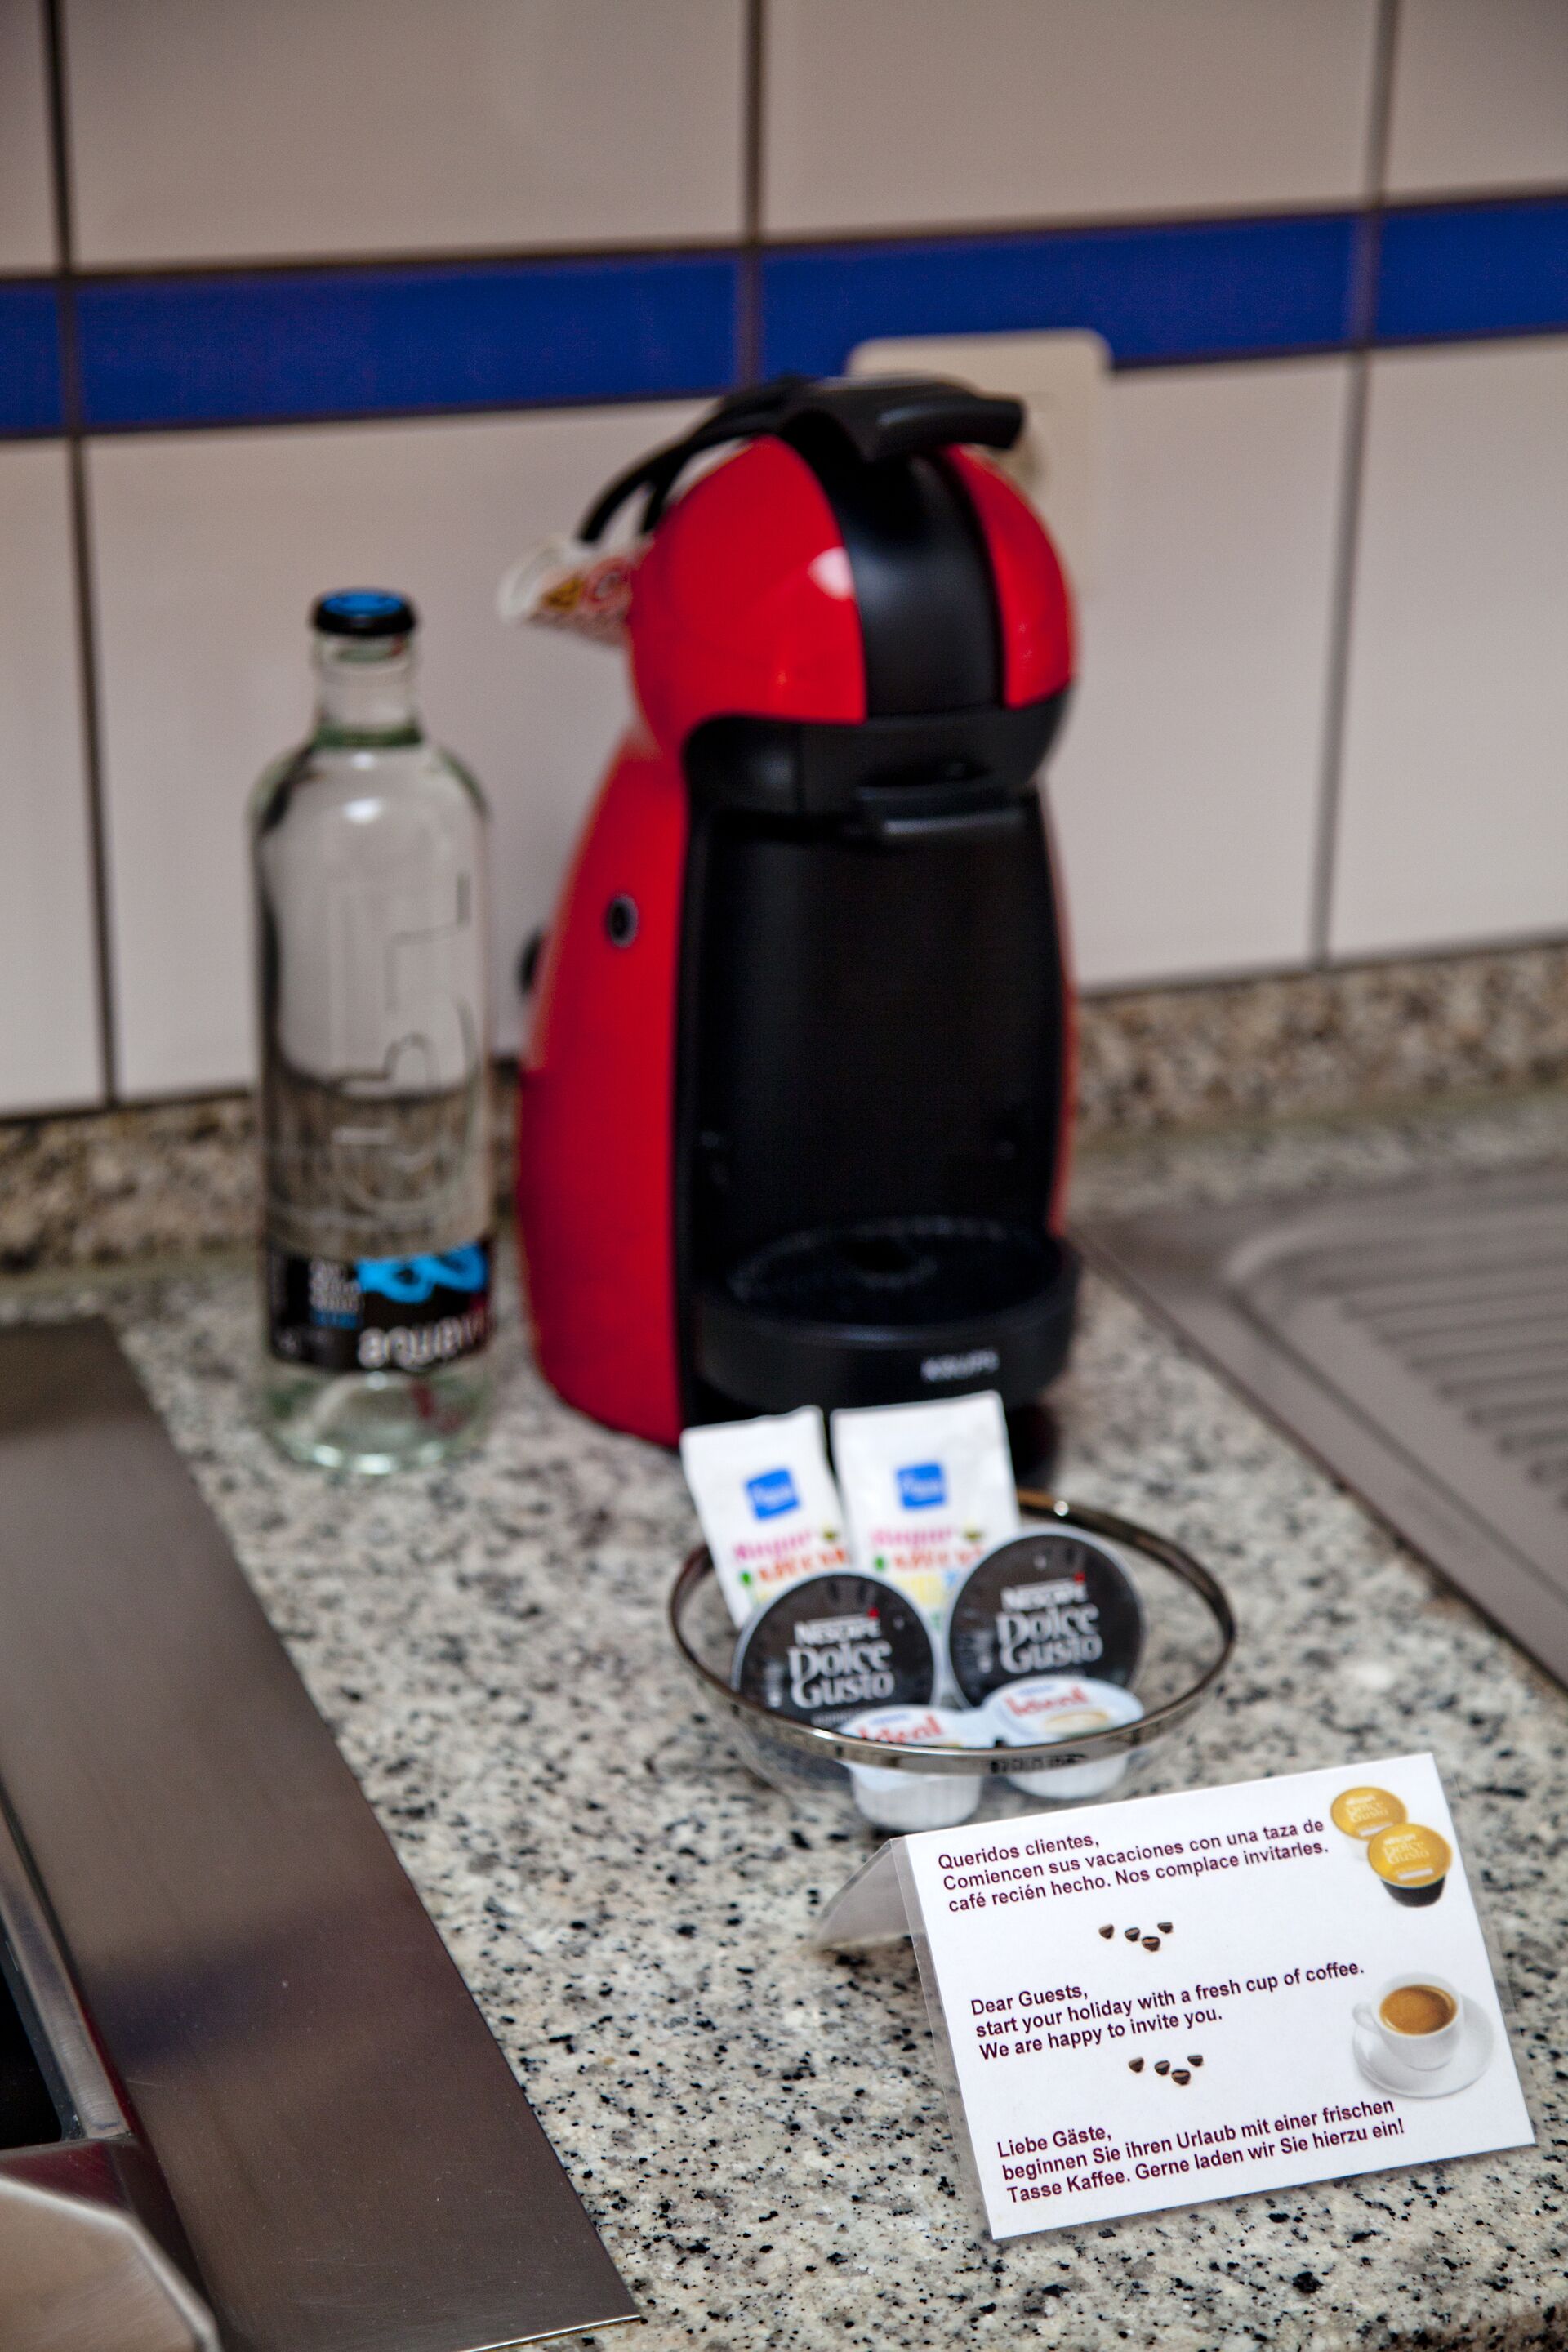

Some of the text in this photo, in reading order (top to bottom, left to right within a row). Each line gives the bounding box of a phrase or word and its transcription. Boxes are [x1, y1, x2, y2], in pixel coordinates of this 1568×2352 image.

[996, 1603, 1100, 1646] Dolce
[788, 1639, 893, 1680] Dolce
[999, 1634, 1103, 1674] Gusto
[791, 1670, 895, 1709] Gusto
[938, 1835, 1100, 1870] Queridos clientes,
[942, 1818, 1325, 1891] Comiencen sus vacaciones con una taza de
[948, 1841, 1329, 1913] café recién hecho. Nos complace invitarles.
[970, 1984, 1088, 2016] Dear Guests,
[975, 1962, 1365, 2038] start your holiday with a fresh cup of coffee.
[978, 2008, 1223, 2060] We are happy to invite you.
[996, 2125, 1112, 2158] Liebe Gäste,
[1001, 2099, 1395, 2181] beginnen Sie ihren Urlaub mit einer frischen
[1006, 2118, 1405, 2203] Tasse Kaffee. Gerne laden wir Sie hierzu ein!
